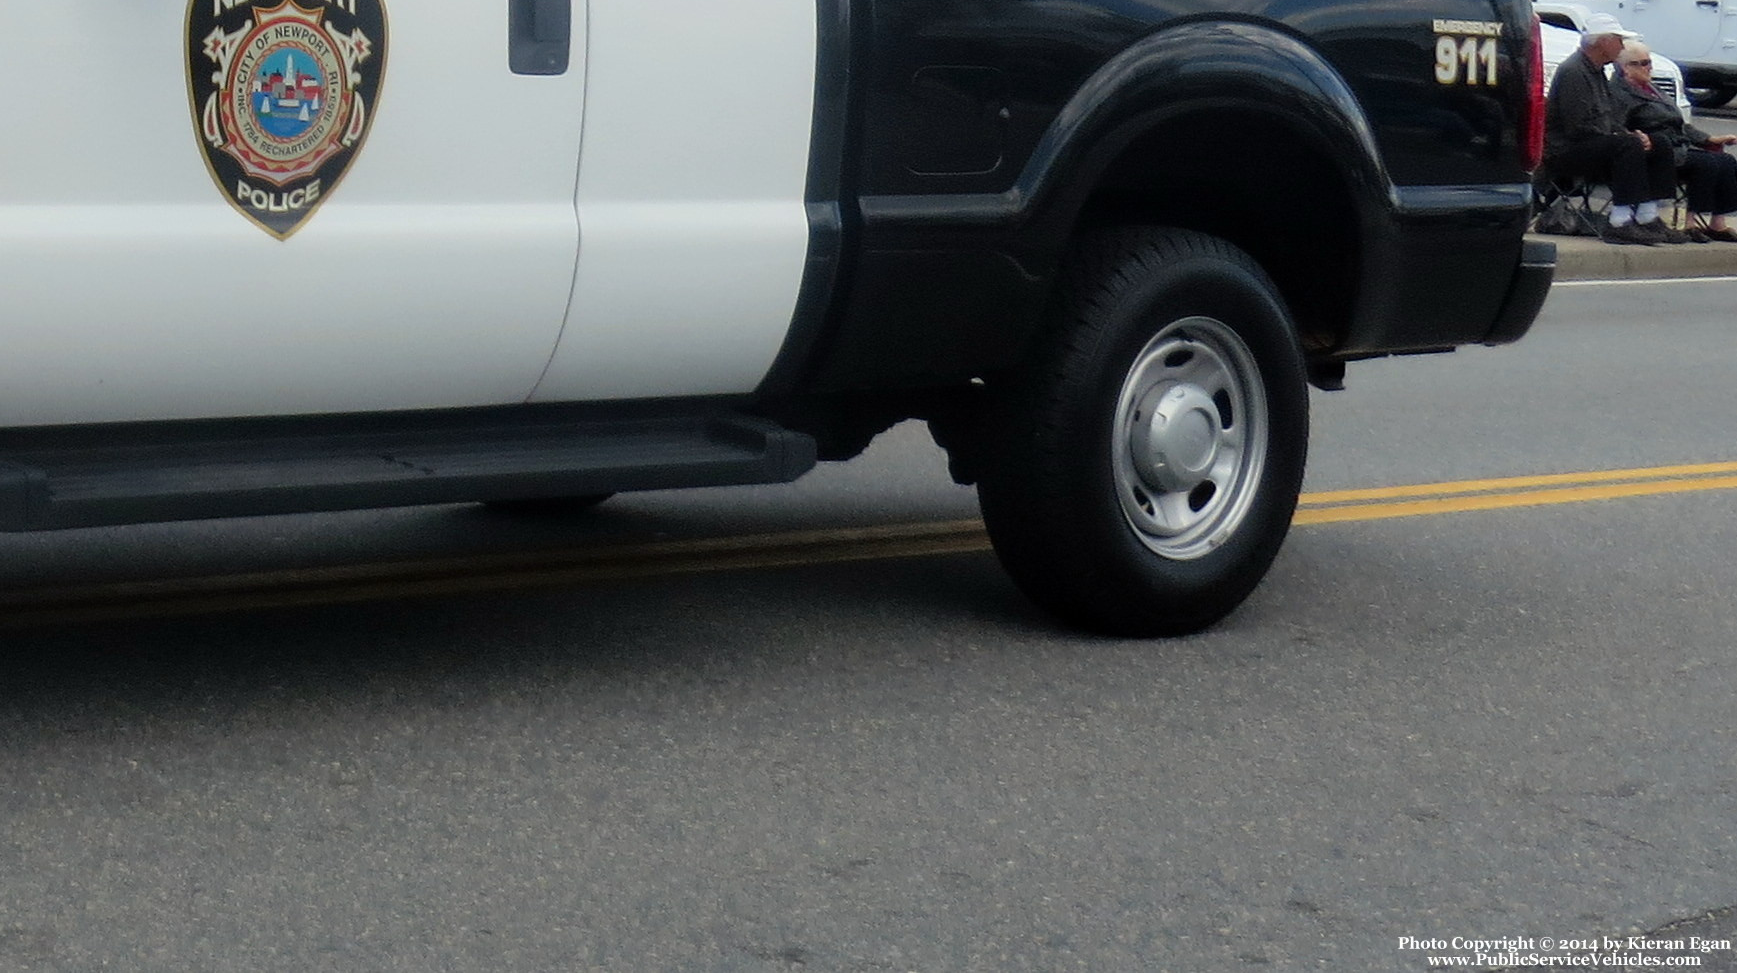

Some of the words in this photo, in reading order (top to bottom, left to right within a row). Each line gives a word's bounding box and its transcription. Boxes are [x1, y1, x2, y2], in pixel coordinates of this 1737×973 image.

[237, 51, 255, 84] CITY
[256, 32, 272, 50] OF
[1435, 35, 1497, 85] 911
[259, 126, 325, 156] RECHARTERED
[237, 178, 321, 212] POLICE
